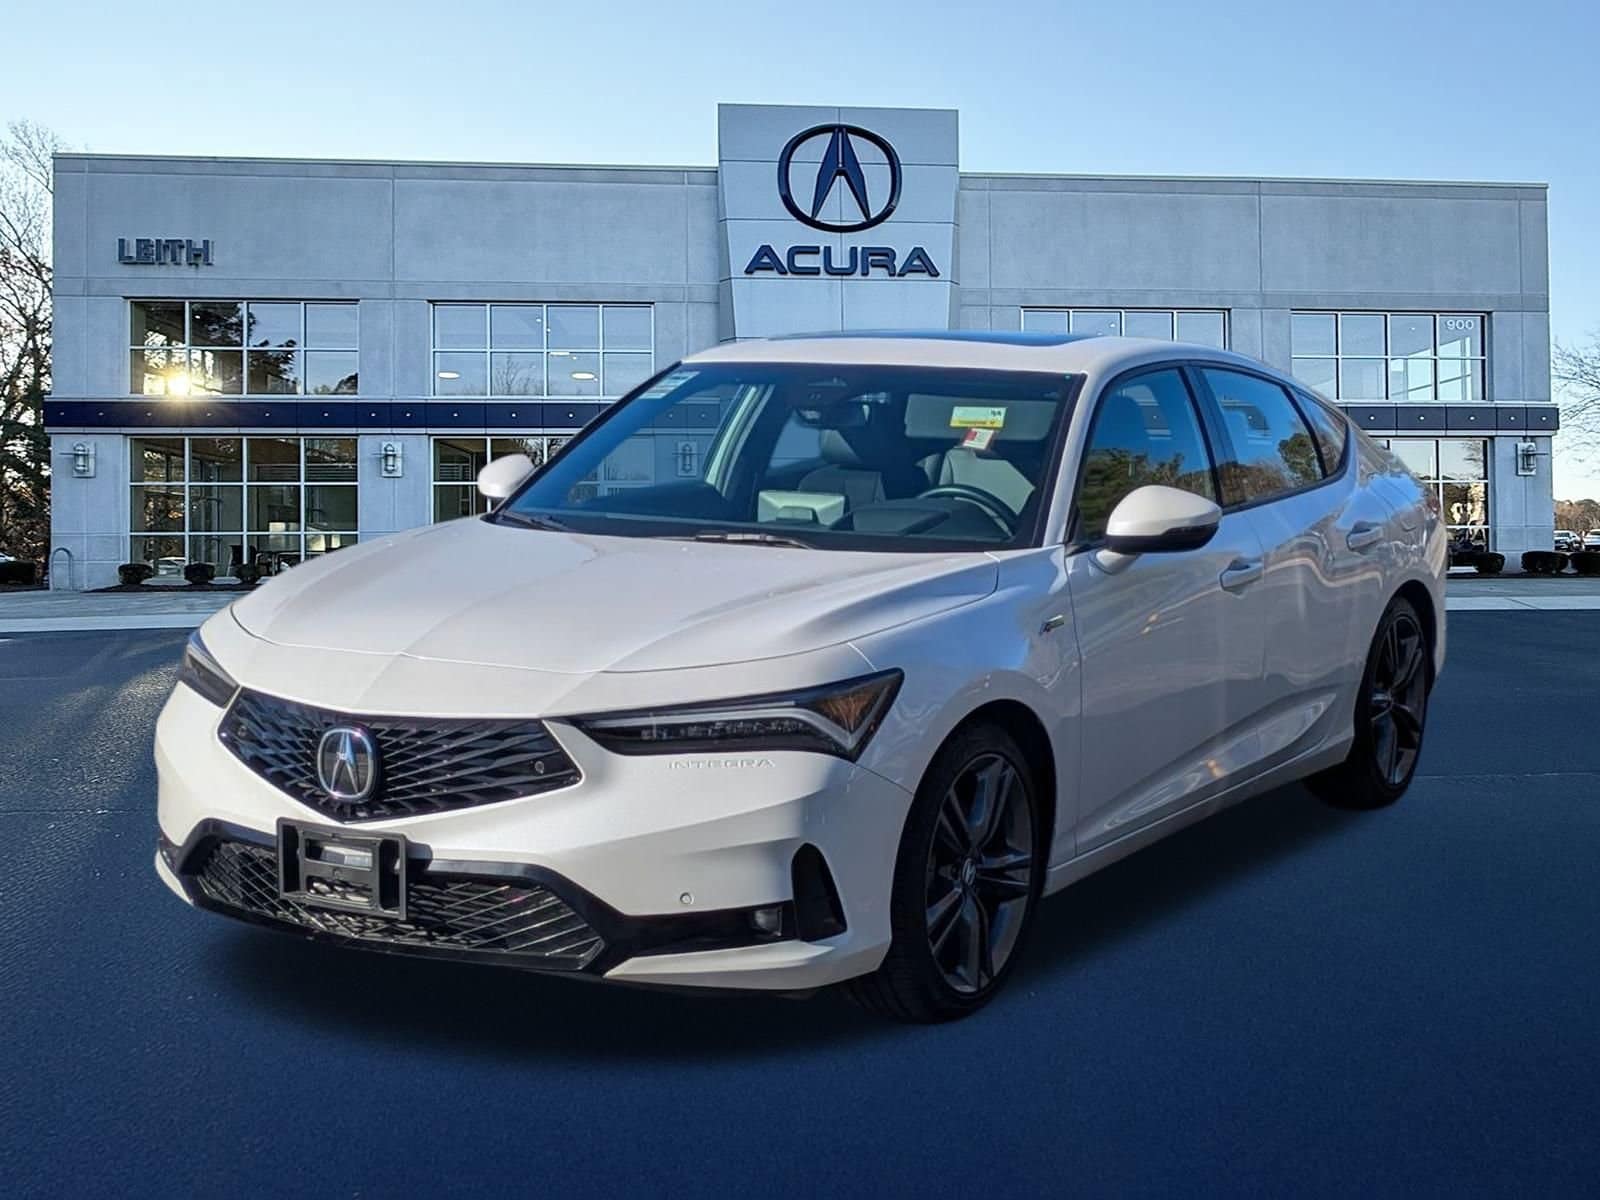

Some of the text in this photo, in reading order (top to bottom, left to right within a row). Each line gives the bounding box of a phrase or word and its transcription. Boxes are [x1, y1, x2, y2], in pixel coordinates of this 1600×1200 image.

[118, 238, 214, 266] LEITH
[744, 245, 940, 278] ACURA
[1446, 319, 1474, 330] 900
[667, 758, 776, 769] INTEGRA
